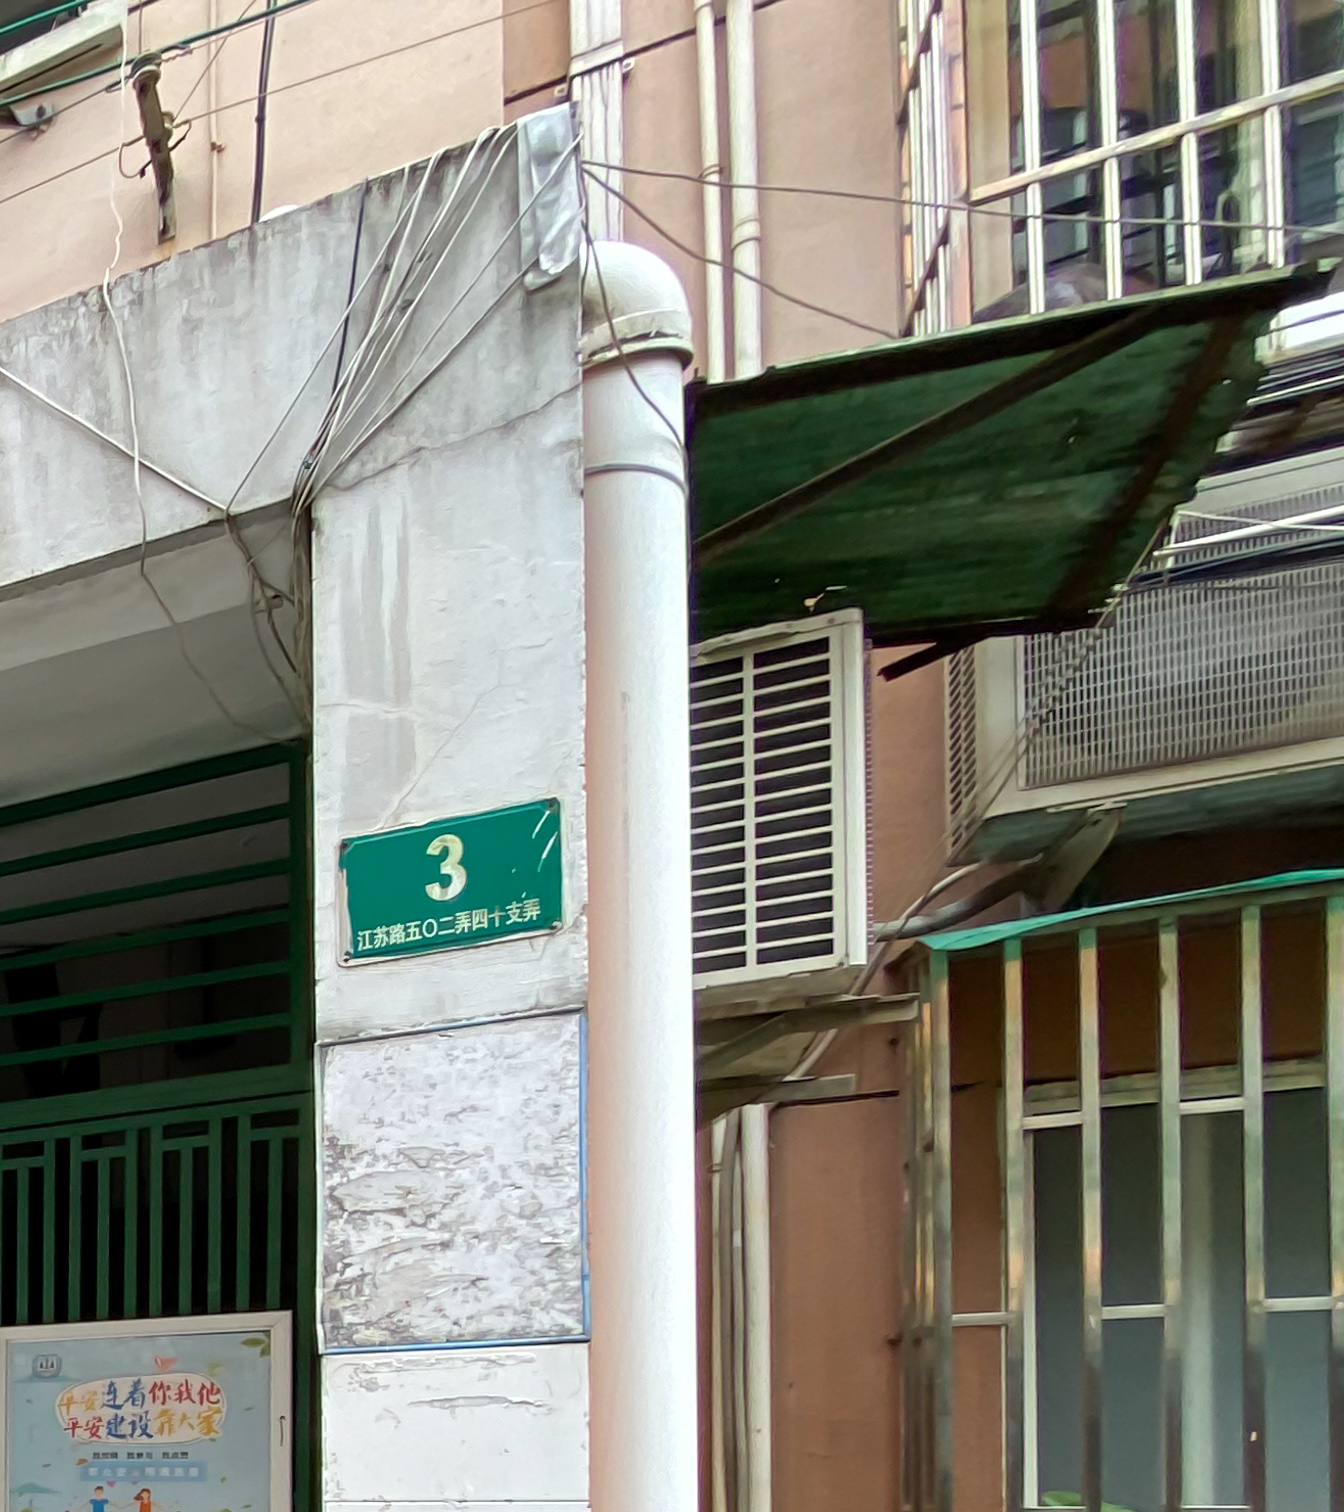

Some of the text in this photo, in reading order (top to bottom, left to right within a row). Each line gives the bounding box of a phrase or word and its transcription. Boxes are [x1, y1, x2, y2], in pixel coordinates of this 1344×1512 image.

[424, 833, 468, 902] 3
[57, 1377, 222, 1416] 平安连着你我他
[63, 1405, 224, 1440] 平安建设靠大家
